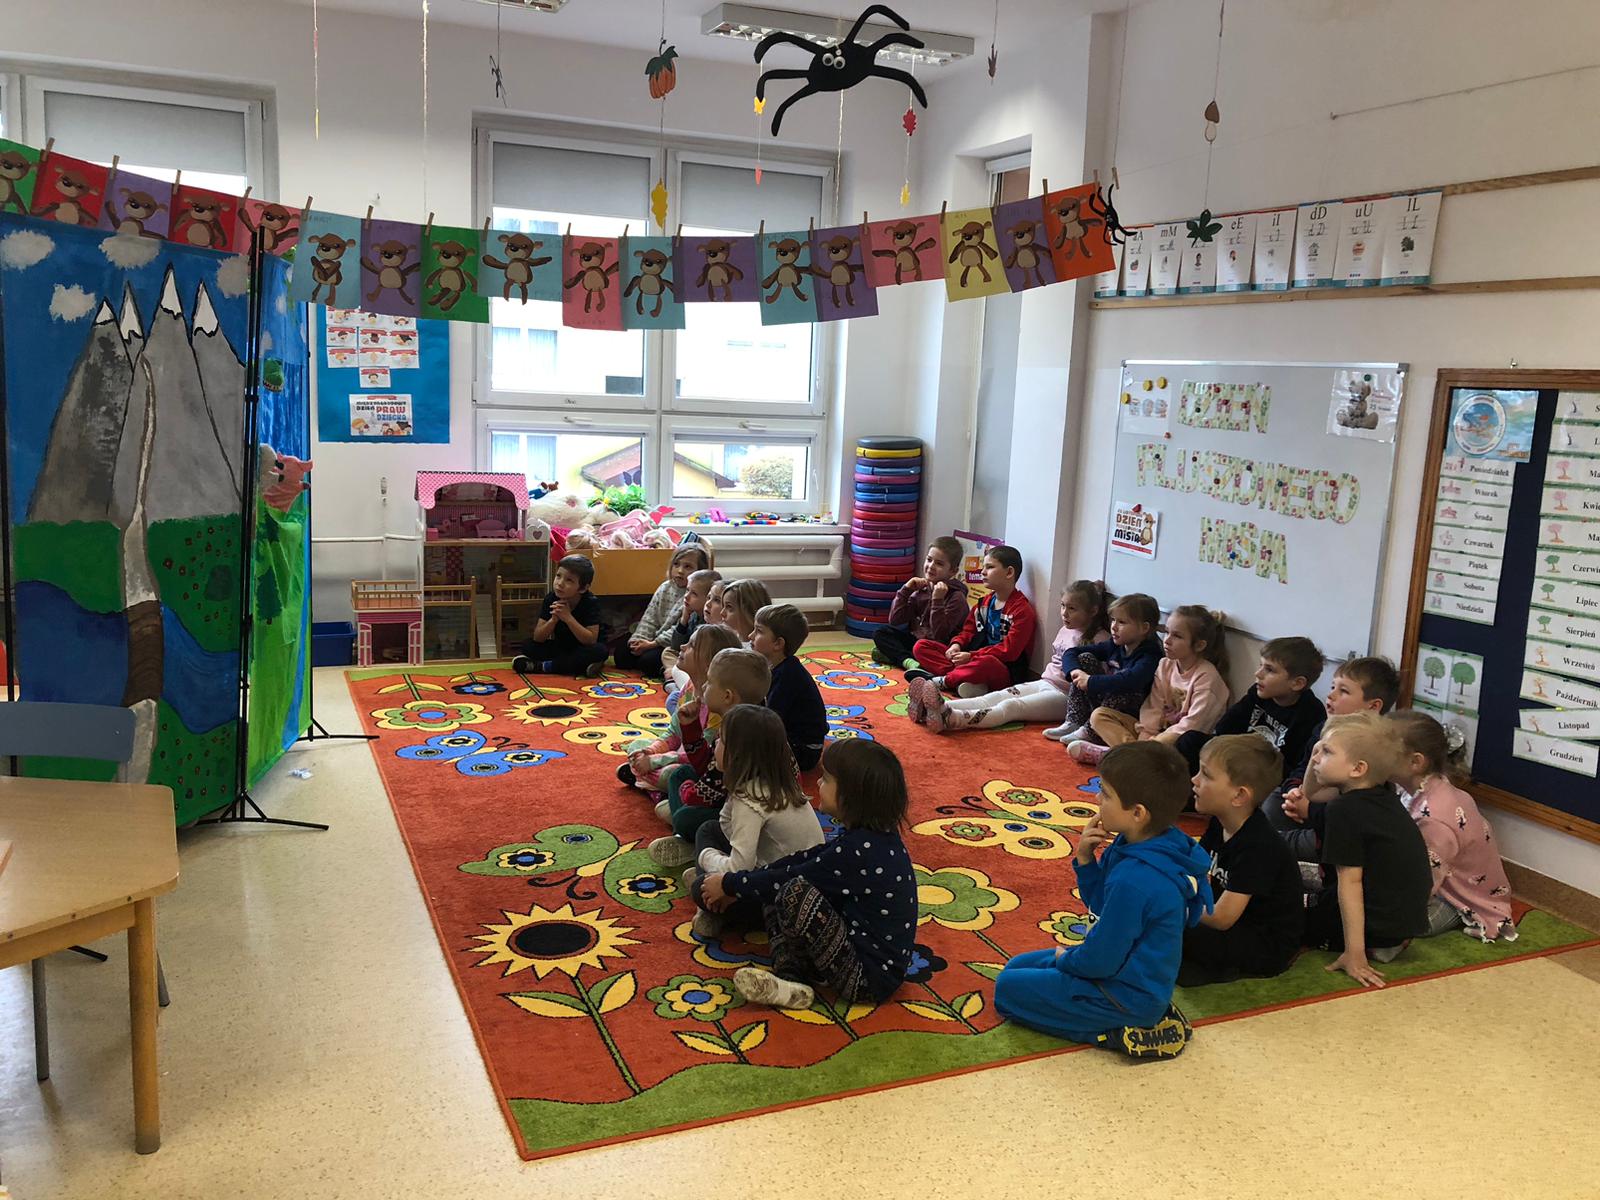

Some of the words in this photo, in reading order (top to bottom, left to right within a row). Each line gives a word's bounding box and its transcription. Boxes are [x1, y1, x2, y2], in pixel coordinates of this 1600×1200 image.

[1310, 206, 1327, 220] dD
[1355, 203, 1374, 218] uU
[1160, 226, 1178, 238] mM
[1576, 596, 1598, 607] Lipiec
[1566, 626, 1596, 638] Sierpień
[1563, 657, 1596, 671] Wrzesień
[1556, 689, 1599, 709] Październik
[1558, 721, 1590, 731] Listopad
[1550, 748, 1584, 763] Grudzień
